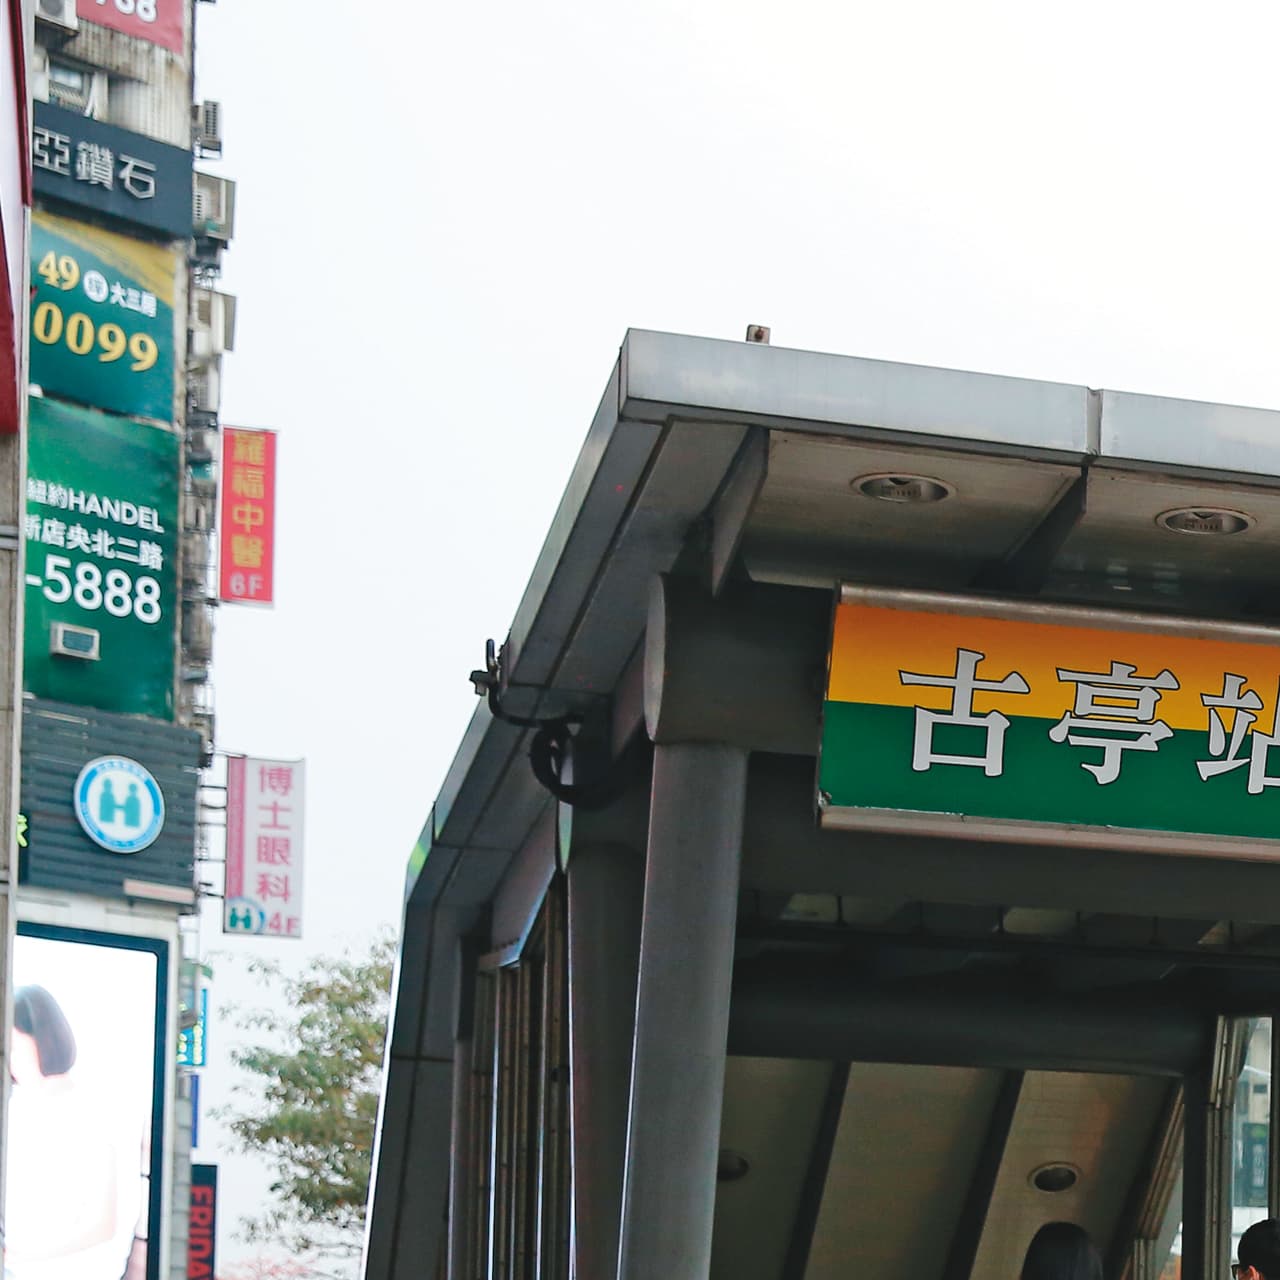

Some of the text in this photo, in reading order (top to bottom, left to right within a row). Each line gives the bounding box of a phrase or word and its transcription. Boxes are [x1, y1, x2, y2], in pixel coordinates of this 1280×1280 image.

[38, 250, 80, 290] 49
[33, 301, 159, 372] 0099
[257, 765, 294, 902] 博士眼科
[268, 911, 301, 934] 4F
